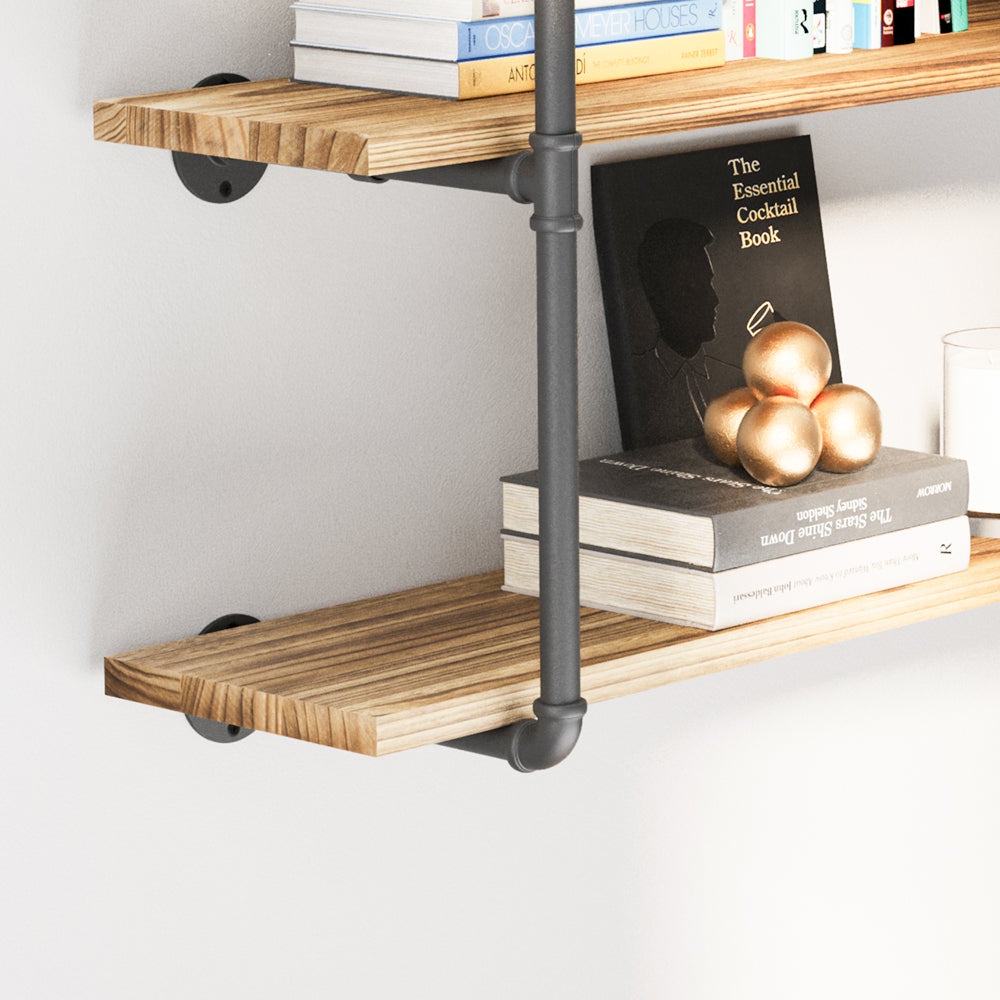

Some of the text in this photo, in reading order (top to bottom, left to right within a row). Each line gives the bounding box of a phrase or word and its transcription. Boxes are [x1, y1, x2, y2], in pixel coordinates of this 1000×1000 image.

[485, 21, 535, 50] OSCA
[634, 3, 698, 32] HOUSES
[727, 156, 761, 176] The
[732, 171, 801, 201] Essential
[736, 196, 799, 224] Cocktail
[739, 225, 782, 249] Book
[916, 481, 952, 498] MORROW
[796, 496, 868, 521] Sidney Sheldon
[760, 507, 893, 547] The Stars Shine Down
[732, 586, 772, 605] Baldessari
[774, 579, 792, 594] John
